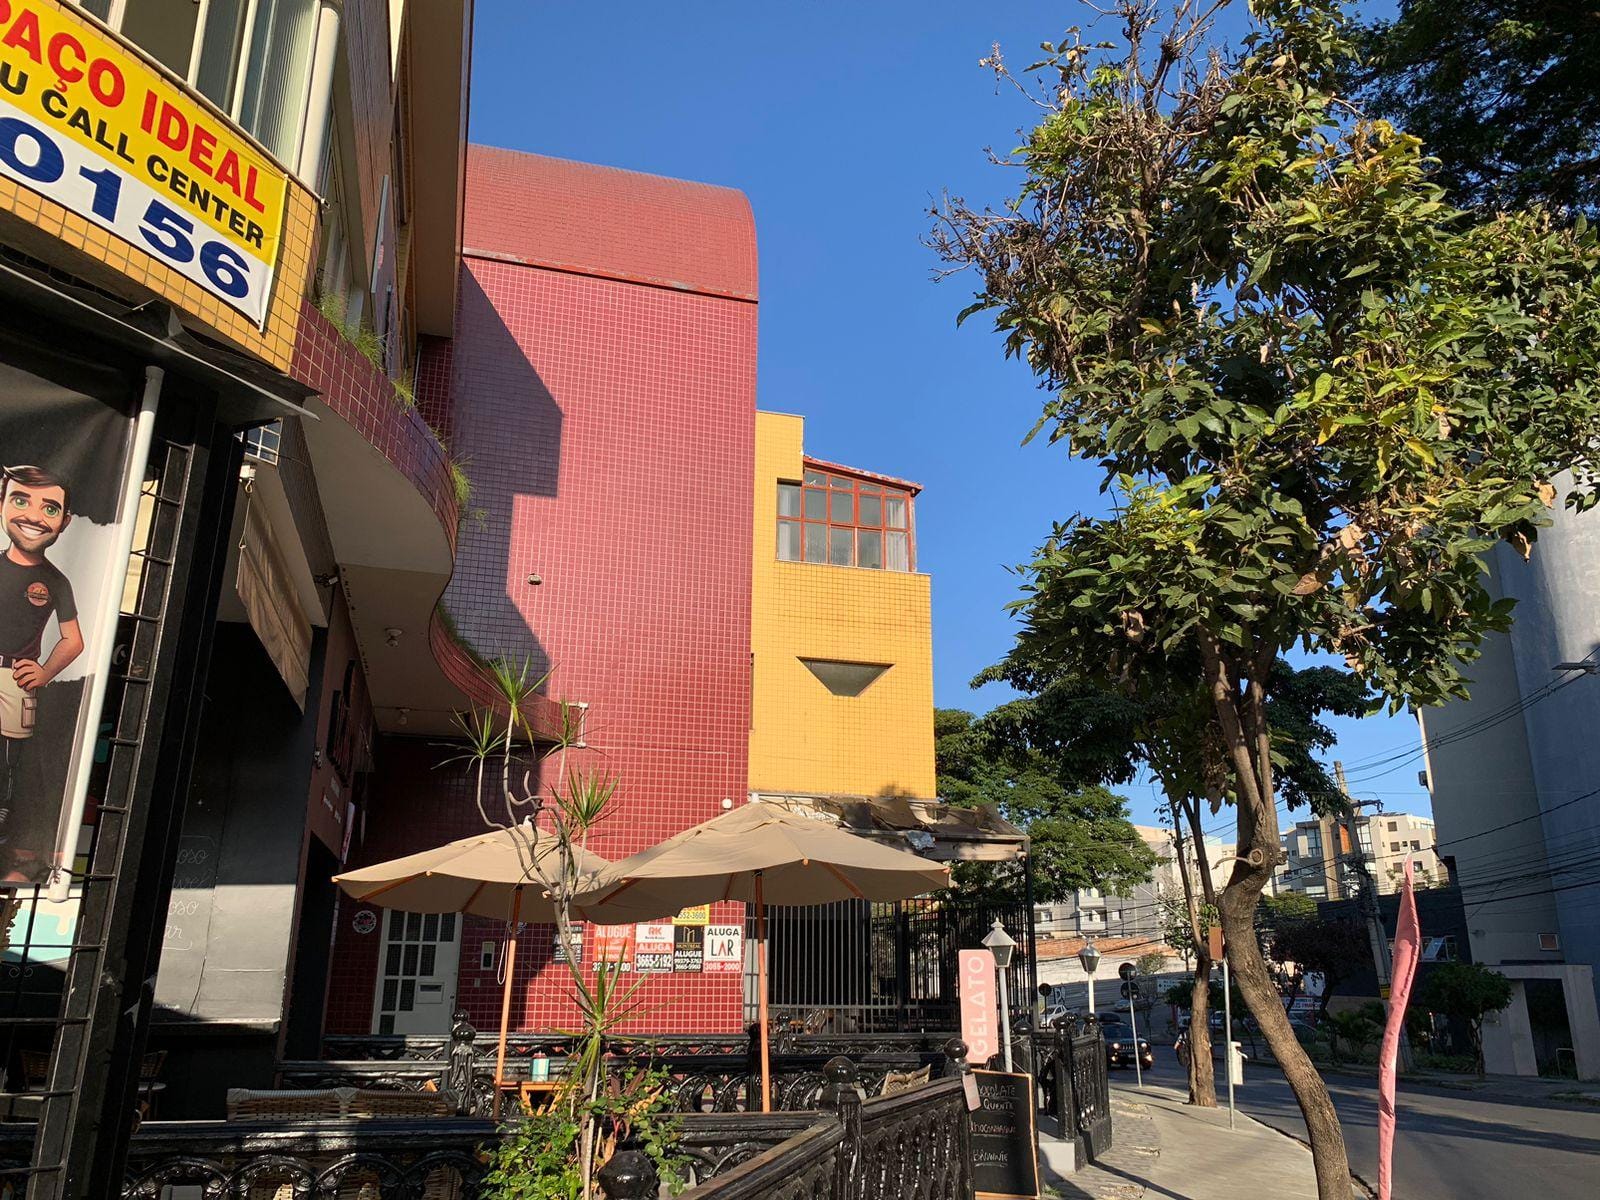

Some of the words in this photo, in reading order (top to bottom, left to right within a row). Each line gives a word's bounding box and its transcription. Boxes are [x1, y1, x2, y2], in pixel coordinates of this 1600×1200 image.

[41, 88, 136, 164] CALL
[146, 154, 265, 250] CENTER
[140, 88, 266, 214] IDEAL
[638, 943, 671, 951] ALUGA
[707, 928, 740, 936] ALUGA
[967, 956, 989, 1056] GELATO
